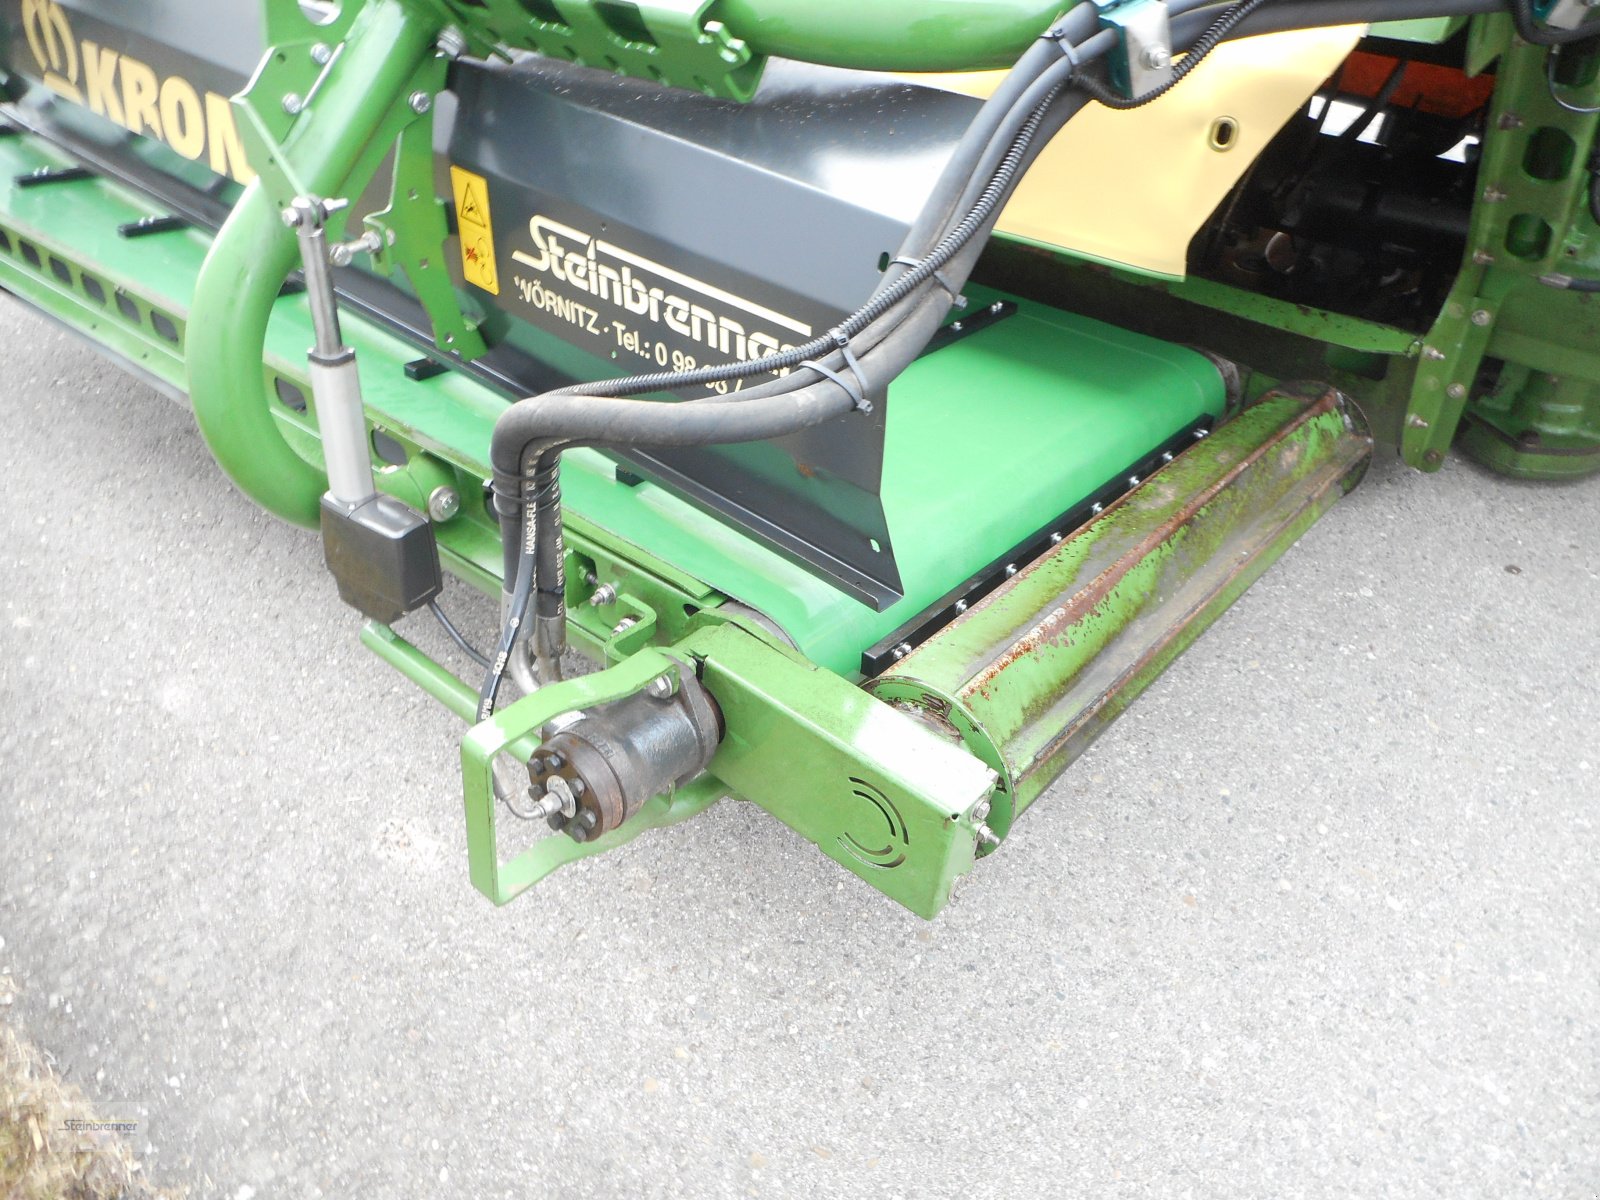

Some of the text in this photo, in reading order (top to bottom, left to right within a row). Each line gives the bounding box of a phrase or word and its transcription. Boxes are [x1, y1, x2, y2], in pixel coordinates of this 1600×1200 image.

[612, 320, 650, 359] Tel.:
[655, 342, 668, 367] 0
[525, 495, 537, 555] HANSA-FLE
